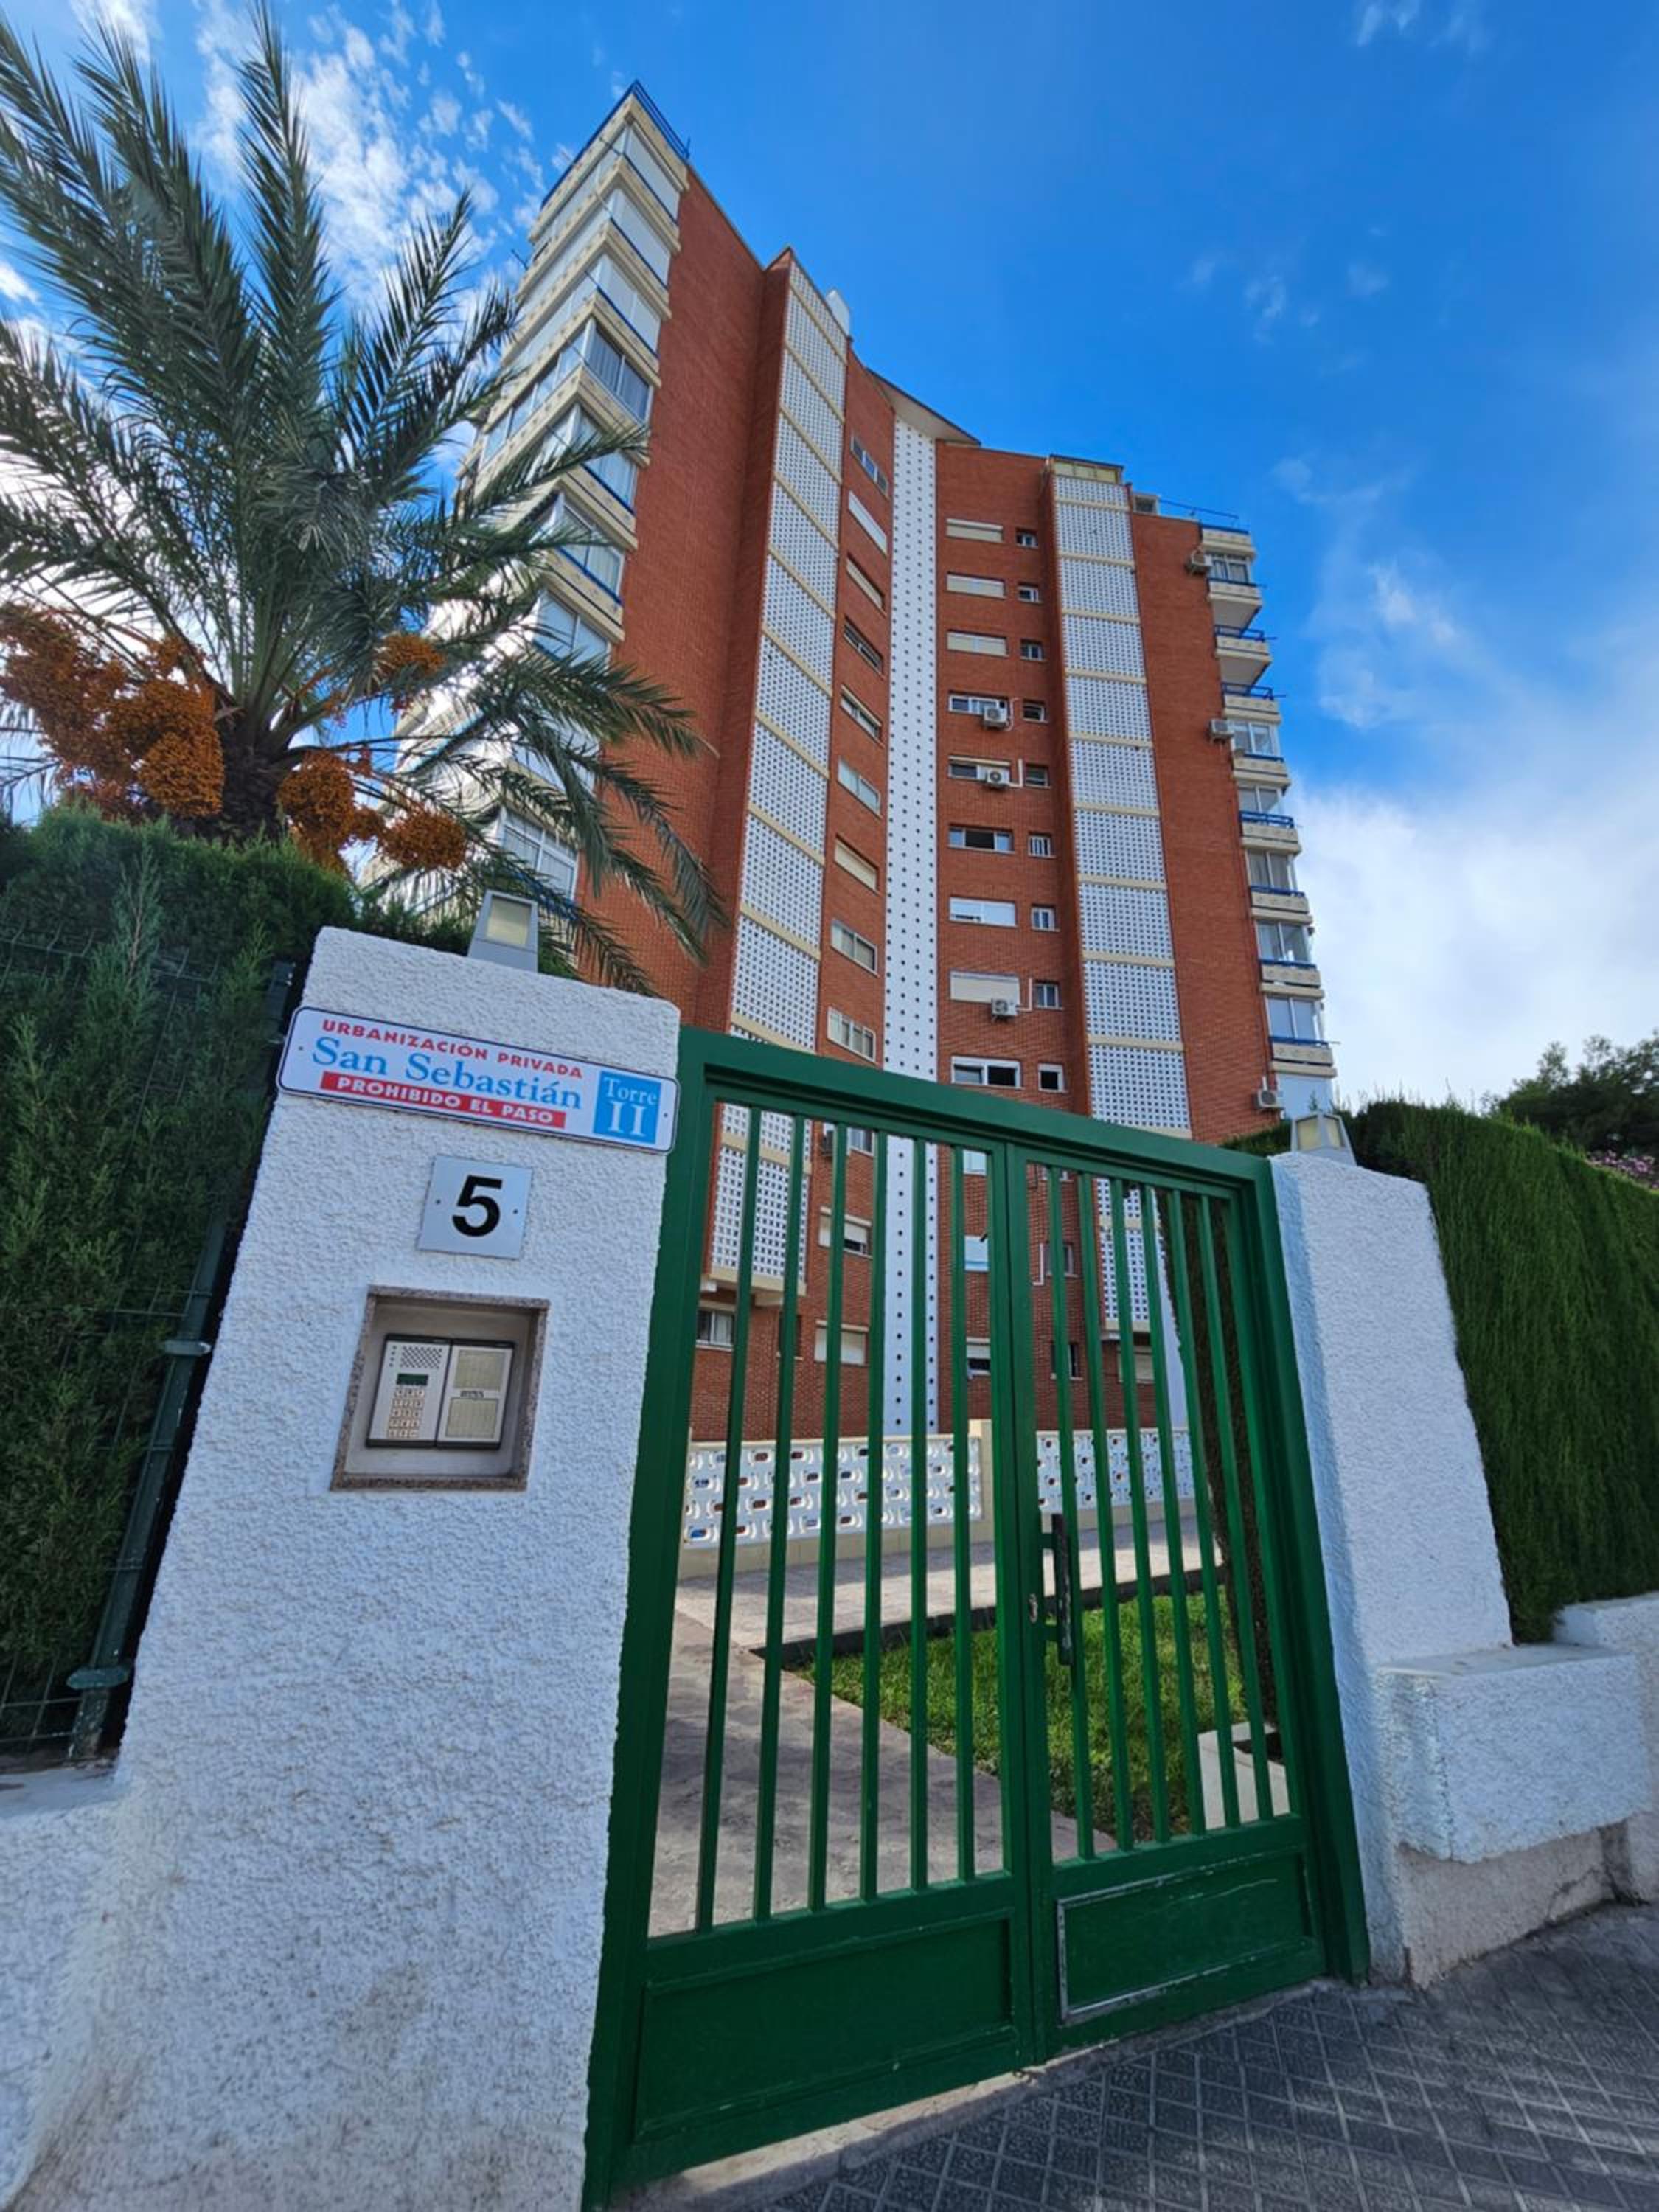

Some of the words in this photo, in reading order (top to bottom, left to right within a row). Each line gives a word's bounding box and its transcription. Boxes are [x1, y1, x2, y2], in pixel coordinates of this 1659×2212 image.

[312, 1037, 387, 1075] San
[406, 1052, 582, 1109] Sebastián
[322, 1019, 488, 1060] URBANIZACIÓN
[498, 1052, 582, 1079] PRIVADA
[337, 1077, 461, 1107] PROHIBIDO
[470, 1099, 493, 1113] EL
[502, 1105, 554, 1124] PASO
[603, 1077, 658, 1105] Torre
[608, 1099, 647, 1138] II
[452, 1175, 503, 1237] 5
